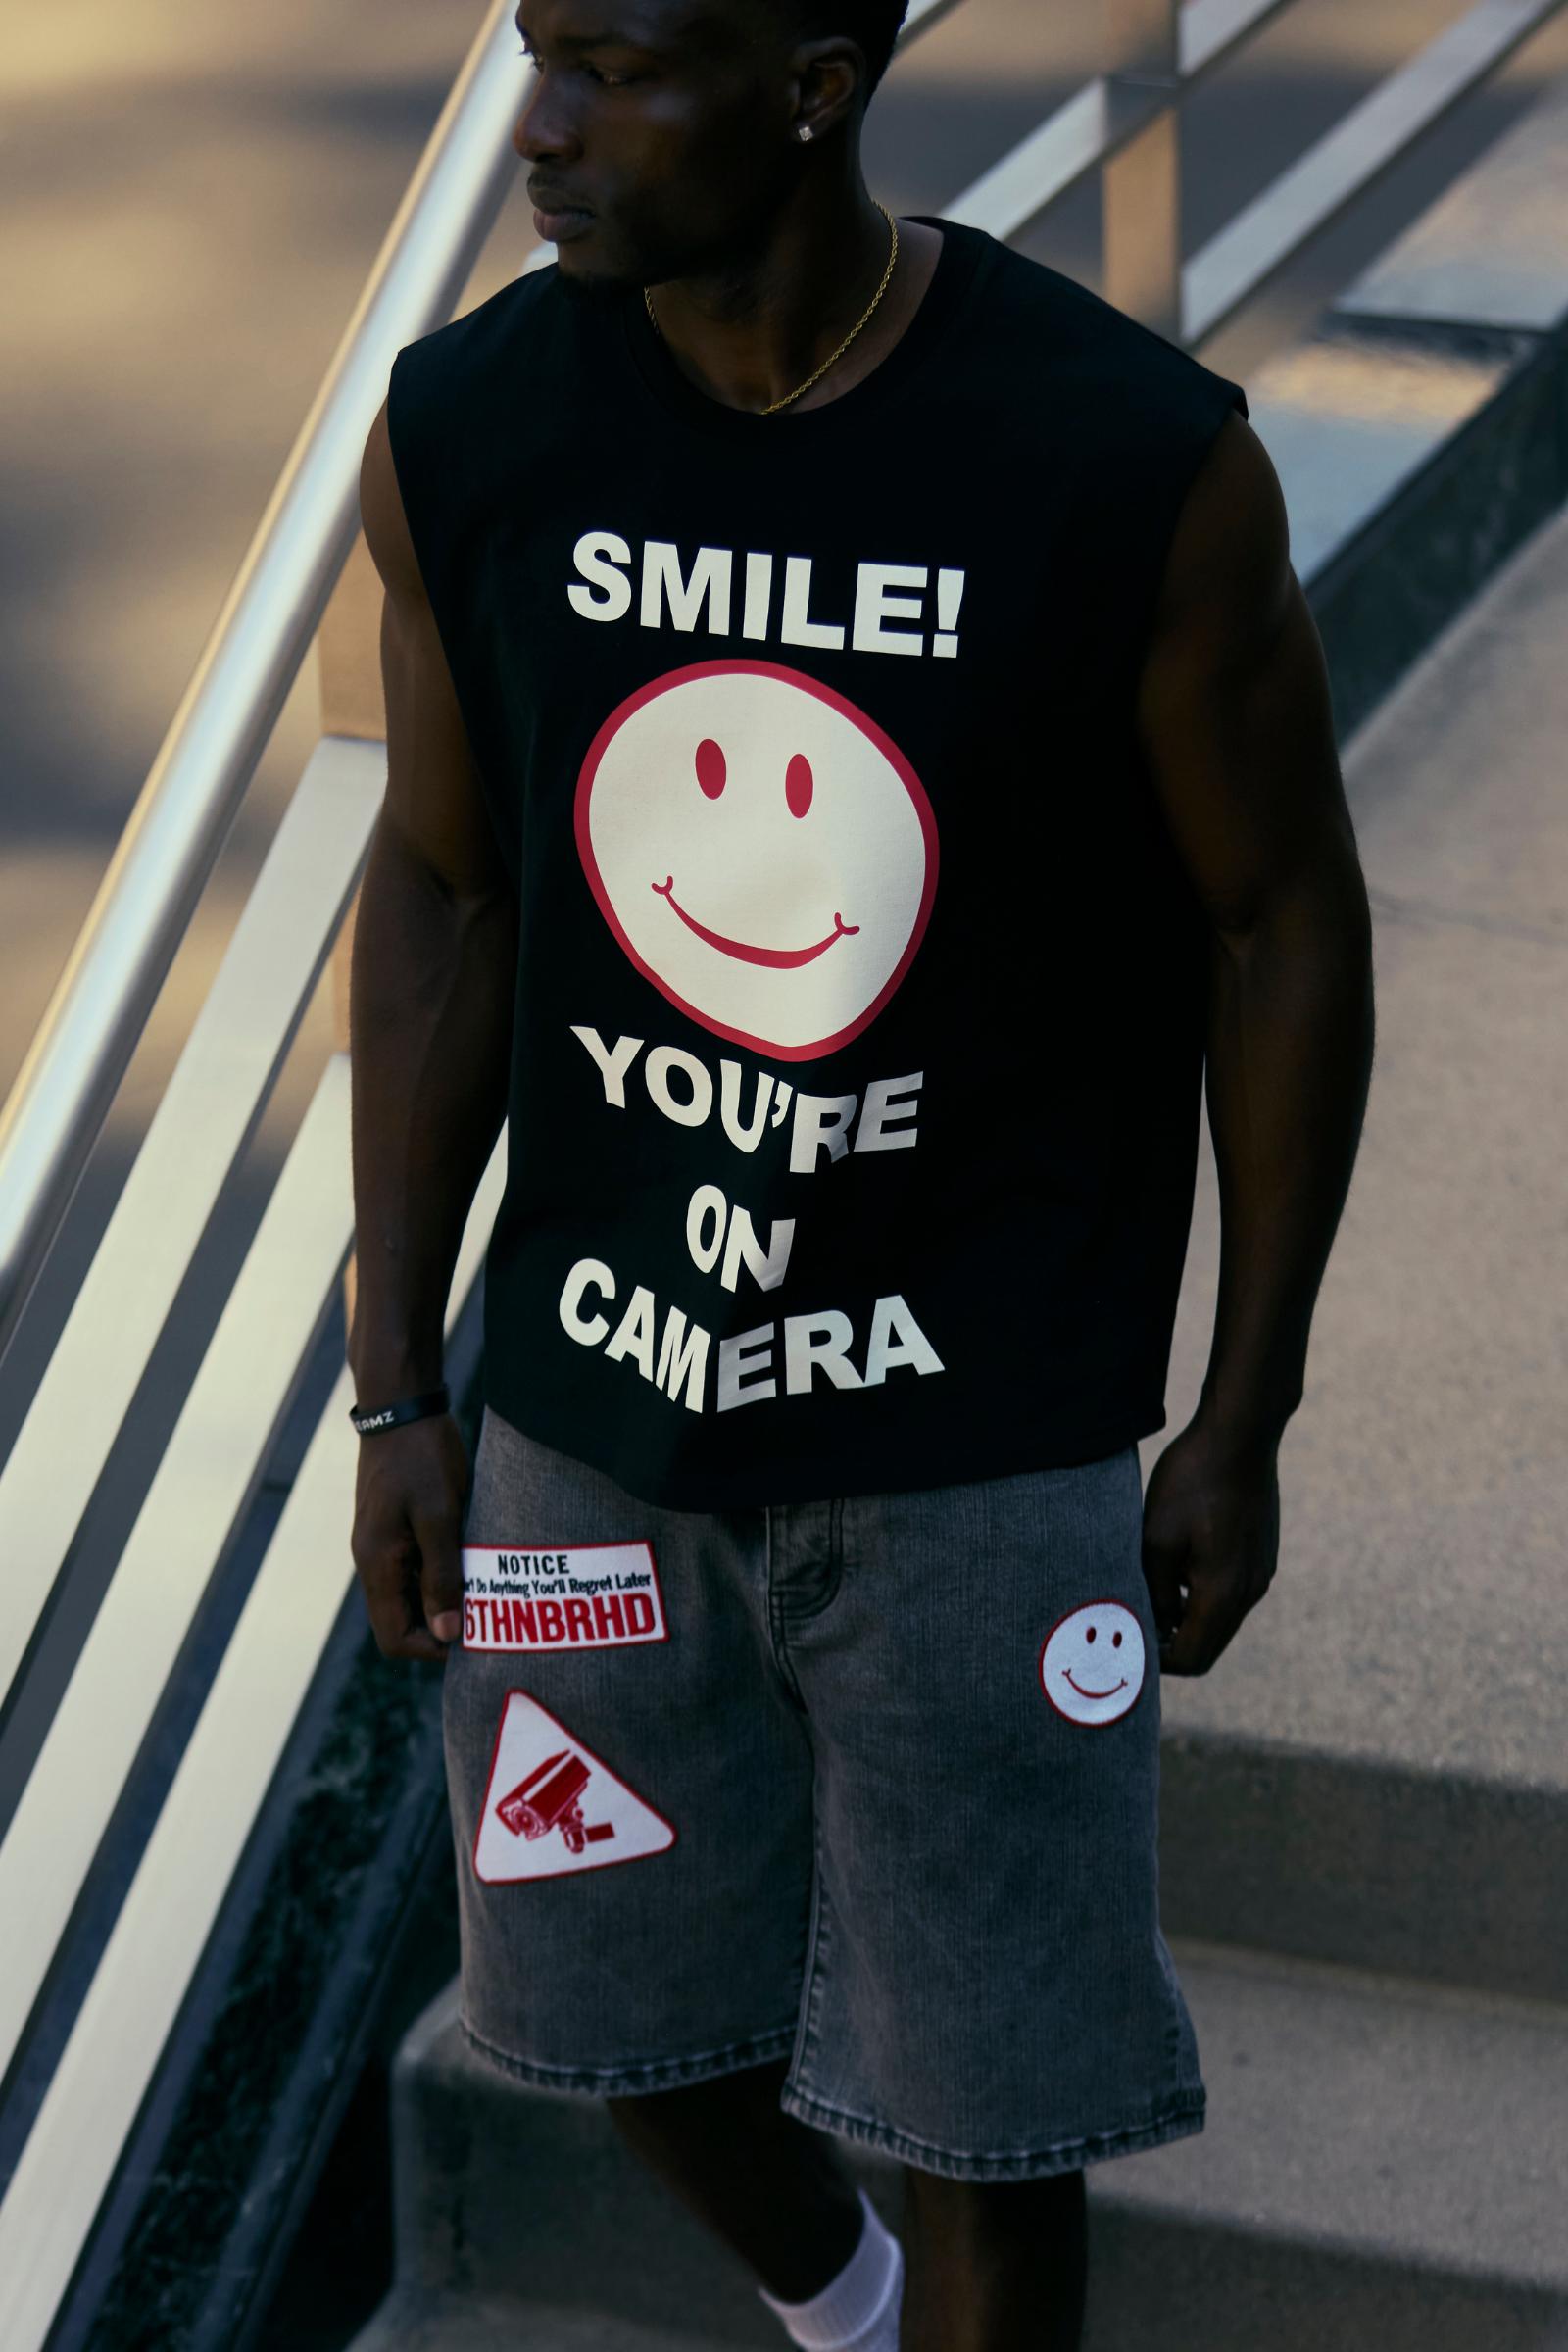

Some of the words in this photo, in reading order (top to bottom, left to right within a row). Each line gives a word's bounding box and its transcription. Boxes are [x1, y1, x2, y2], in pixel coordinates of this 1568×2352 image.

[567, 531, 965, 659] SMILE!
[569, 1025, 924, 1173] YOU'RE
[686, 1184, 796, 1293] ON
[558, 1258, 946, 1413] CAMERA
[476, 1578, 487, 1593] Do
[489, 1578, 530, 1599] Anything
[531, 1579, 565, 1595] You'll
[569, 1575, 612, 1596] Regret
[616, 1572, 652, 1590] Later
[498, 1554, 570, 1575] NOTICE
